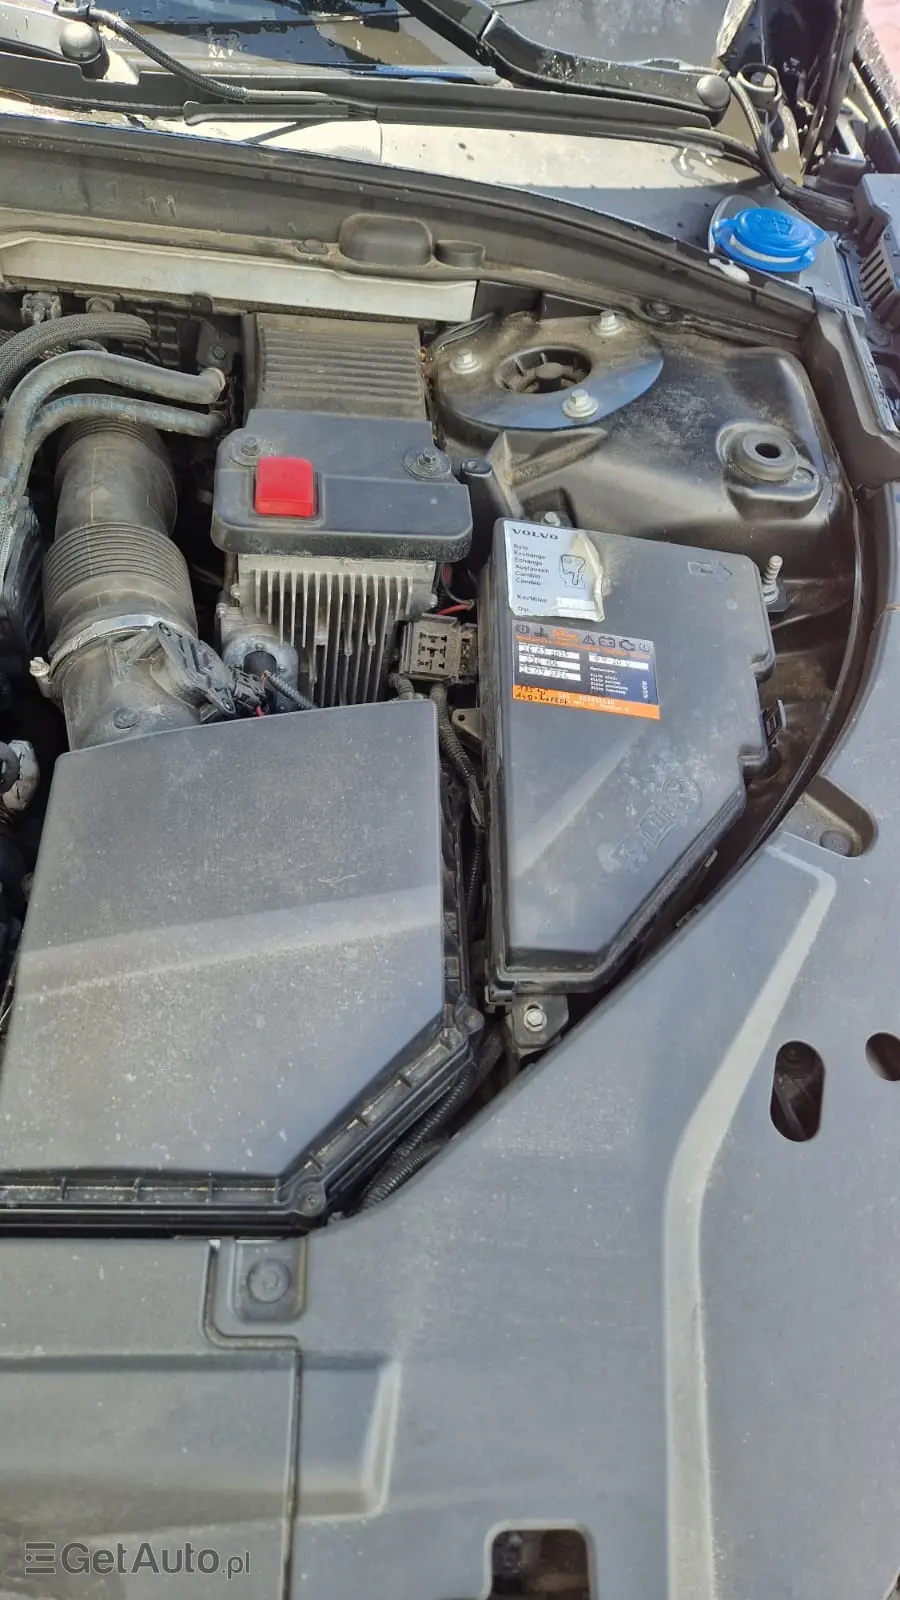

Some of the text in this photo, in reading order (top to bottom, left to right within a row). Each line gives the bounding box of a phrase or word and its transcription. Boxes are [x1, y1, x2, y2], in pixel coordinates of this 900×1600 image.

[512, 528, 559, 540] VOLVO
[514, 550, 547, 560] Exchange
[515, 564, 550, 574] Austausch
